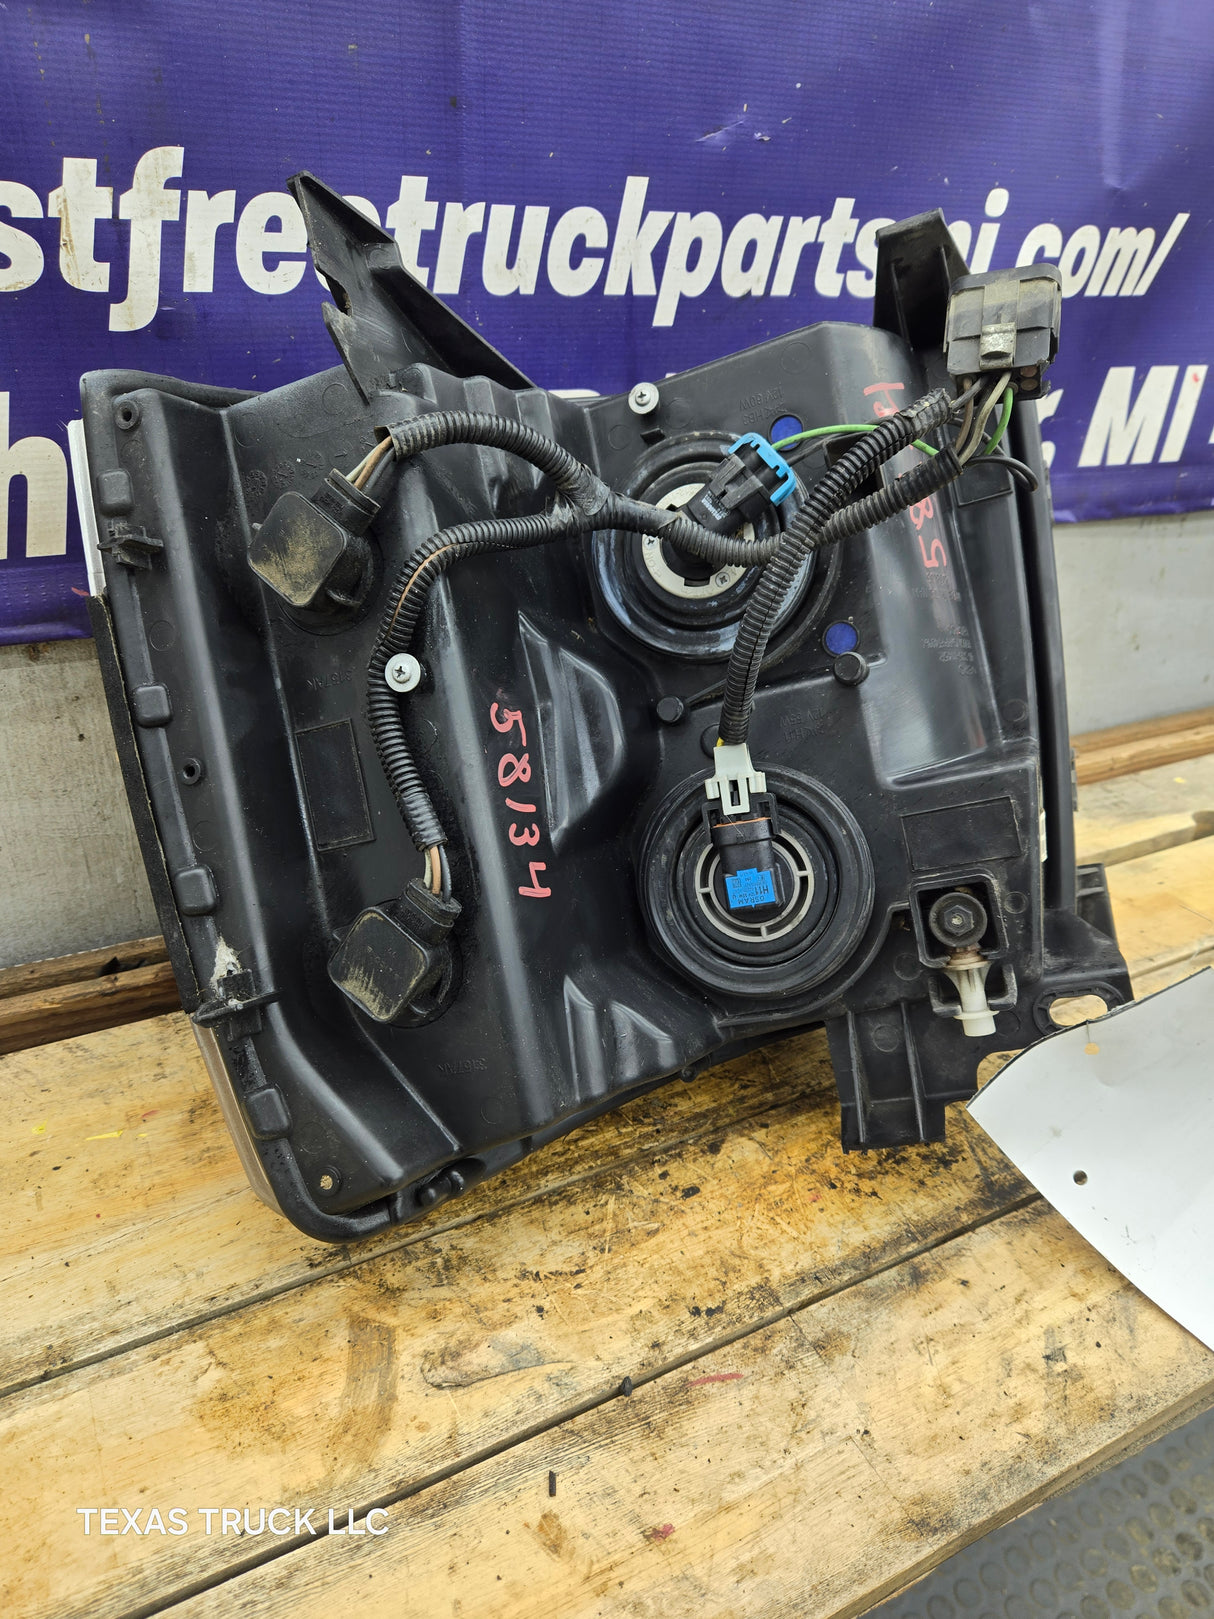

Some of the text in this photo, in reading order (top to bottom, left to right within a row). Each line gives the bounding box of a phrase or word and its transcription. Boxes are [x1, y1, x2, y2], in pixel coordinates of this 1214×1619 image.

[1077, 364, 1209, 468] MI
[490, 702, 552, 898] 58134
[737, 894, 765, 905] OSRAM
